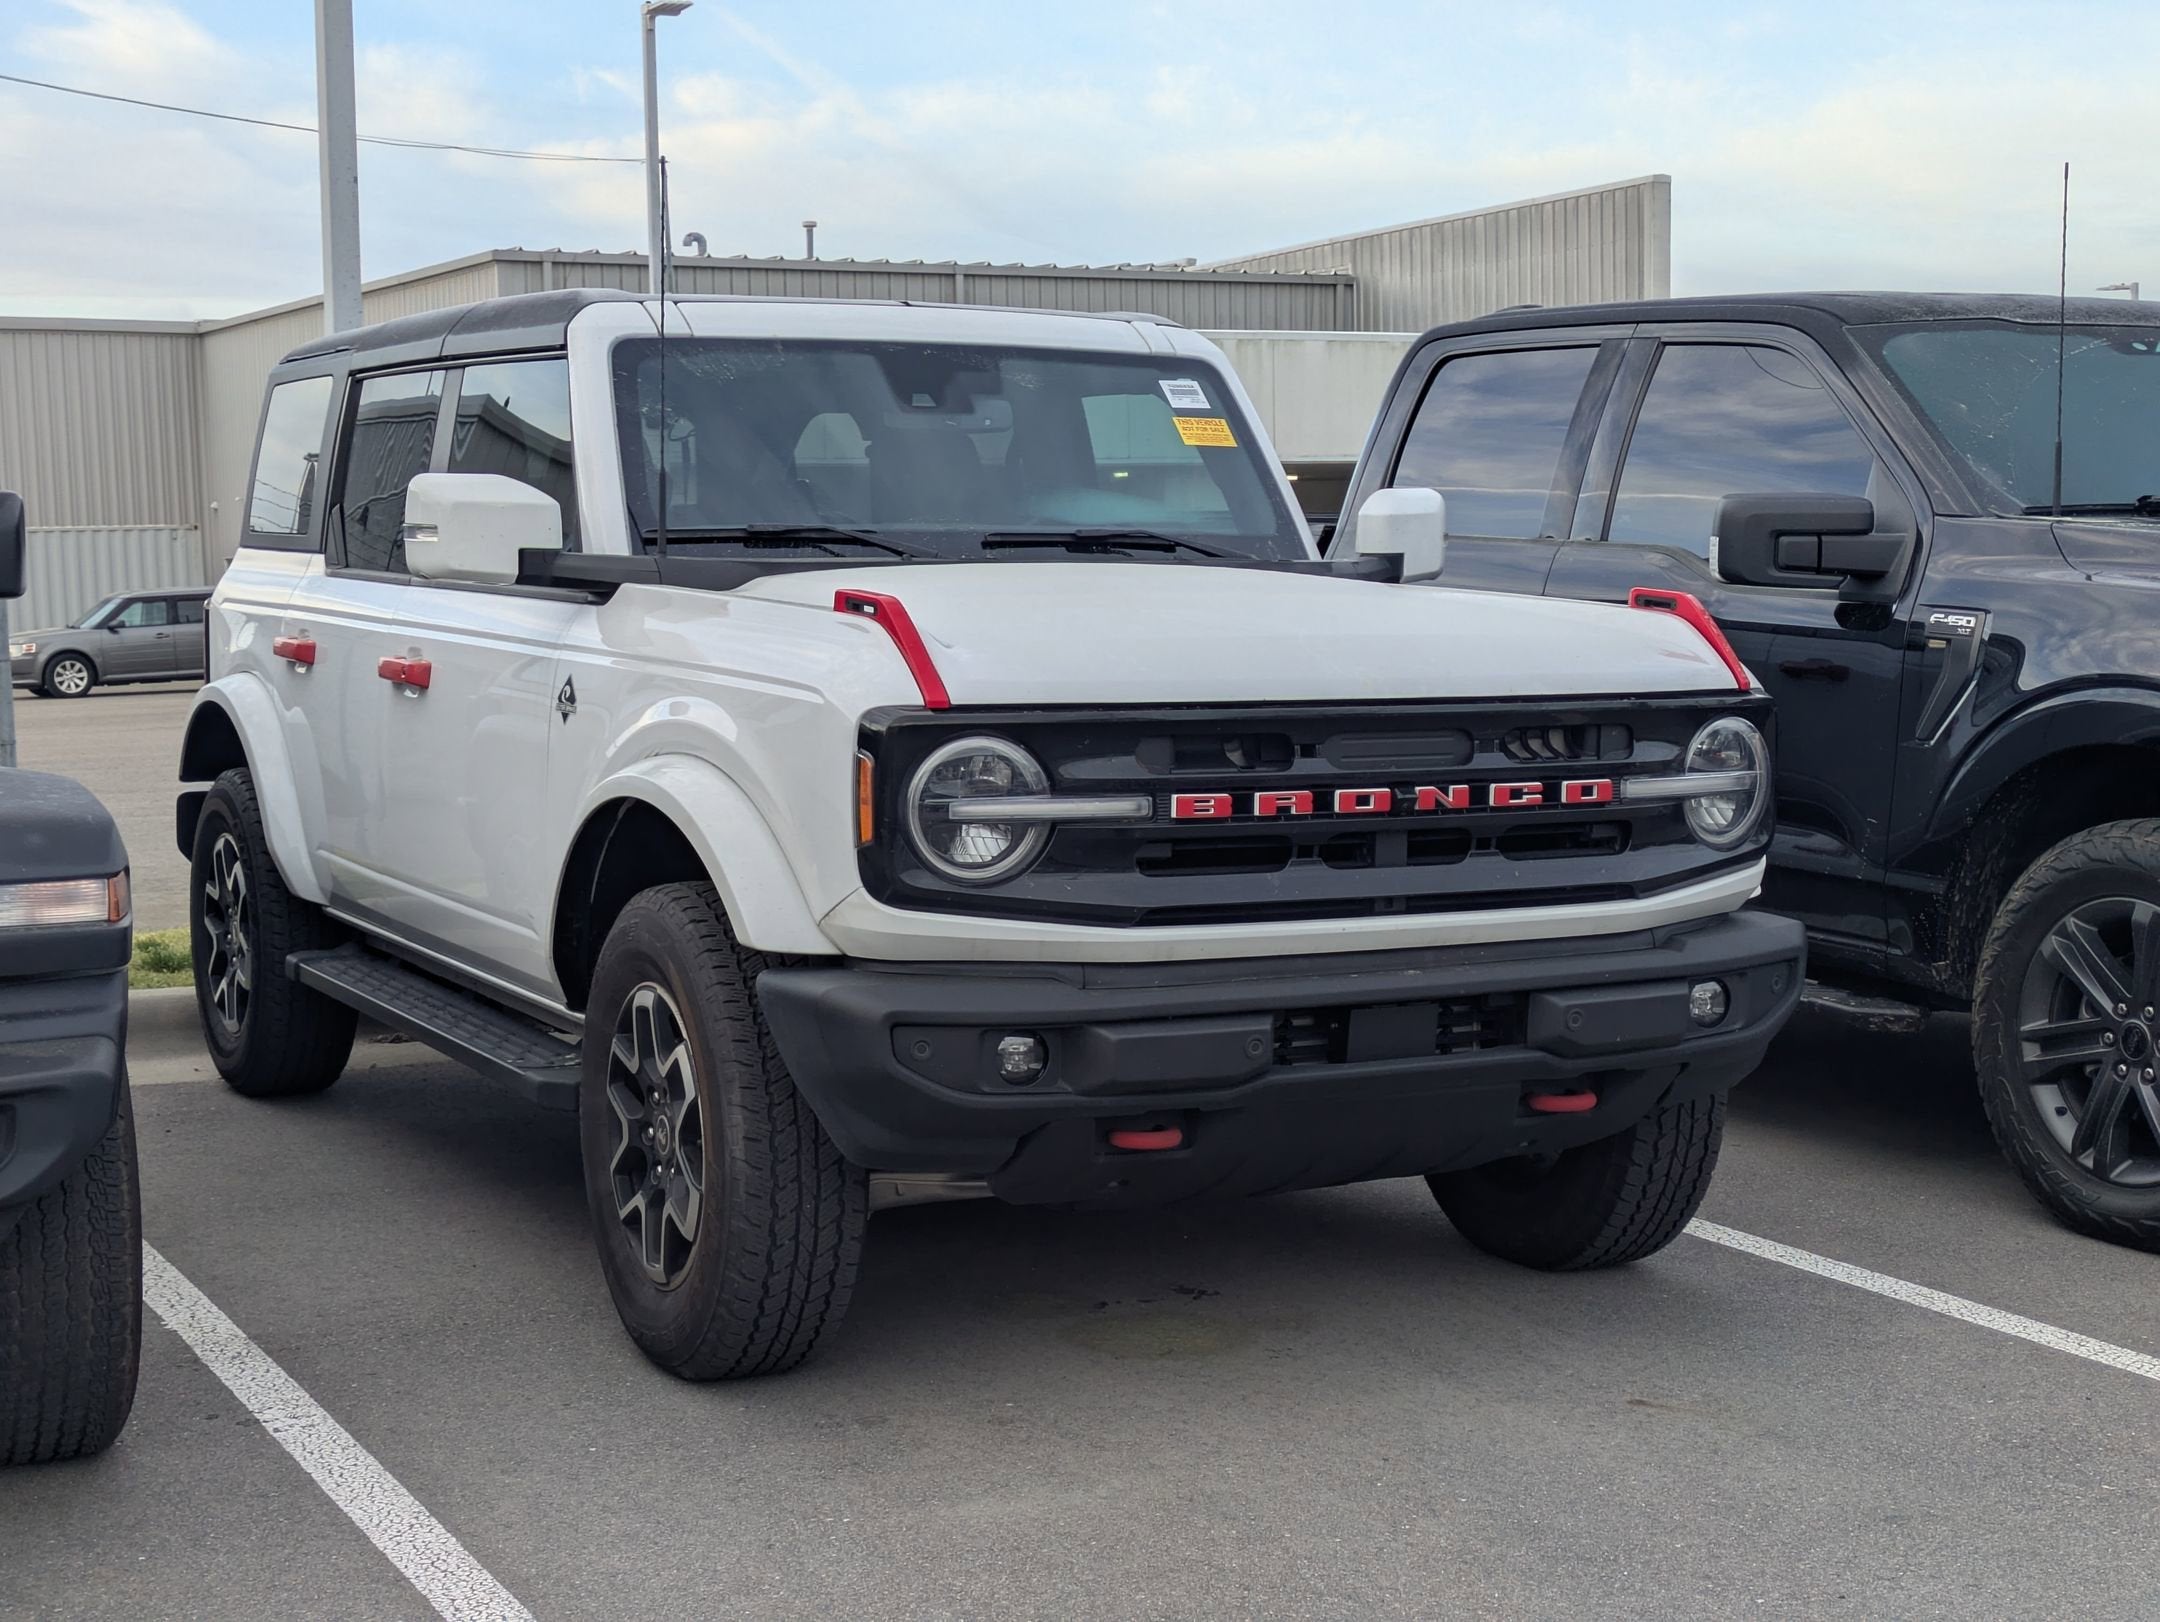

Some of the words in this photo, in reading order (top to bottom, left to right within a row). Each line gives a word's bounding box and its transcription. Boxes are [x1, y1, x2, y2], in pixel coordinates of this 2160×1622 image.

[1194, 419, 1225, 427] VEHICLE
[1930, 613, 1976, 627] F-150
[1171, 778, 1613, 819] BRONCO
